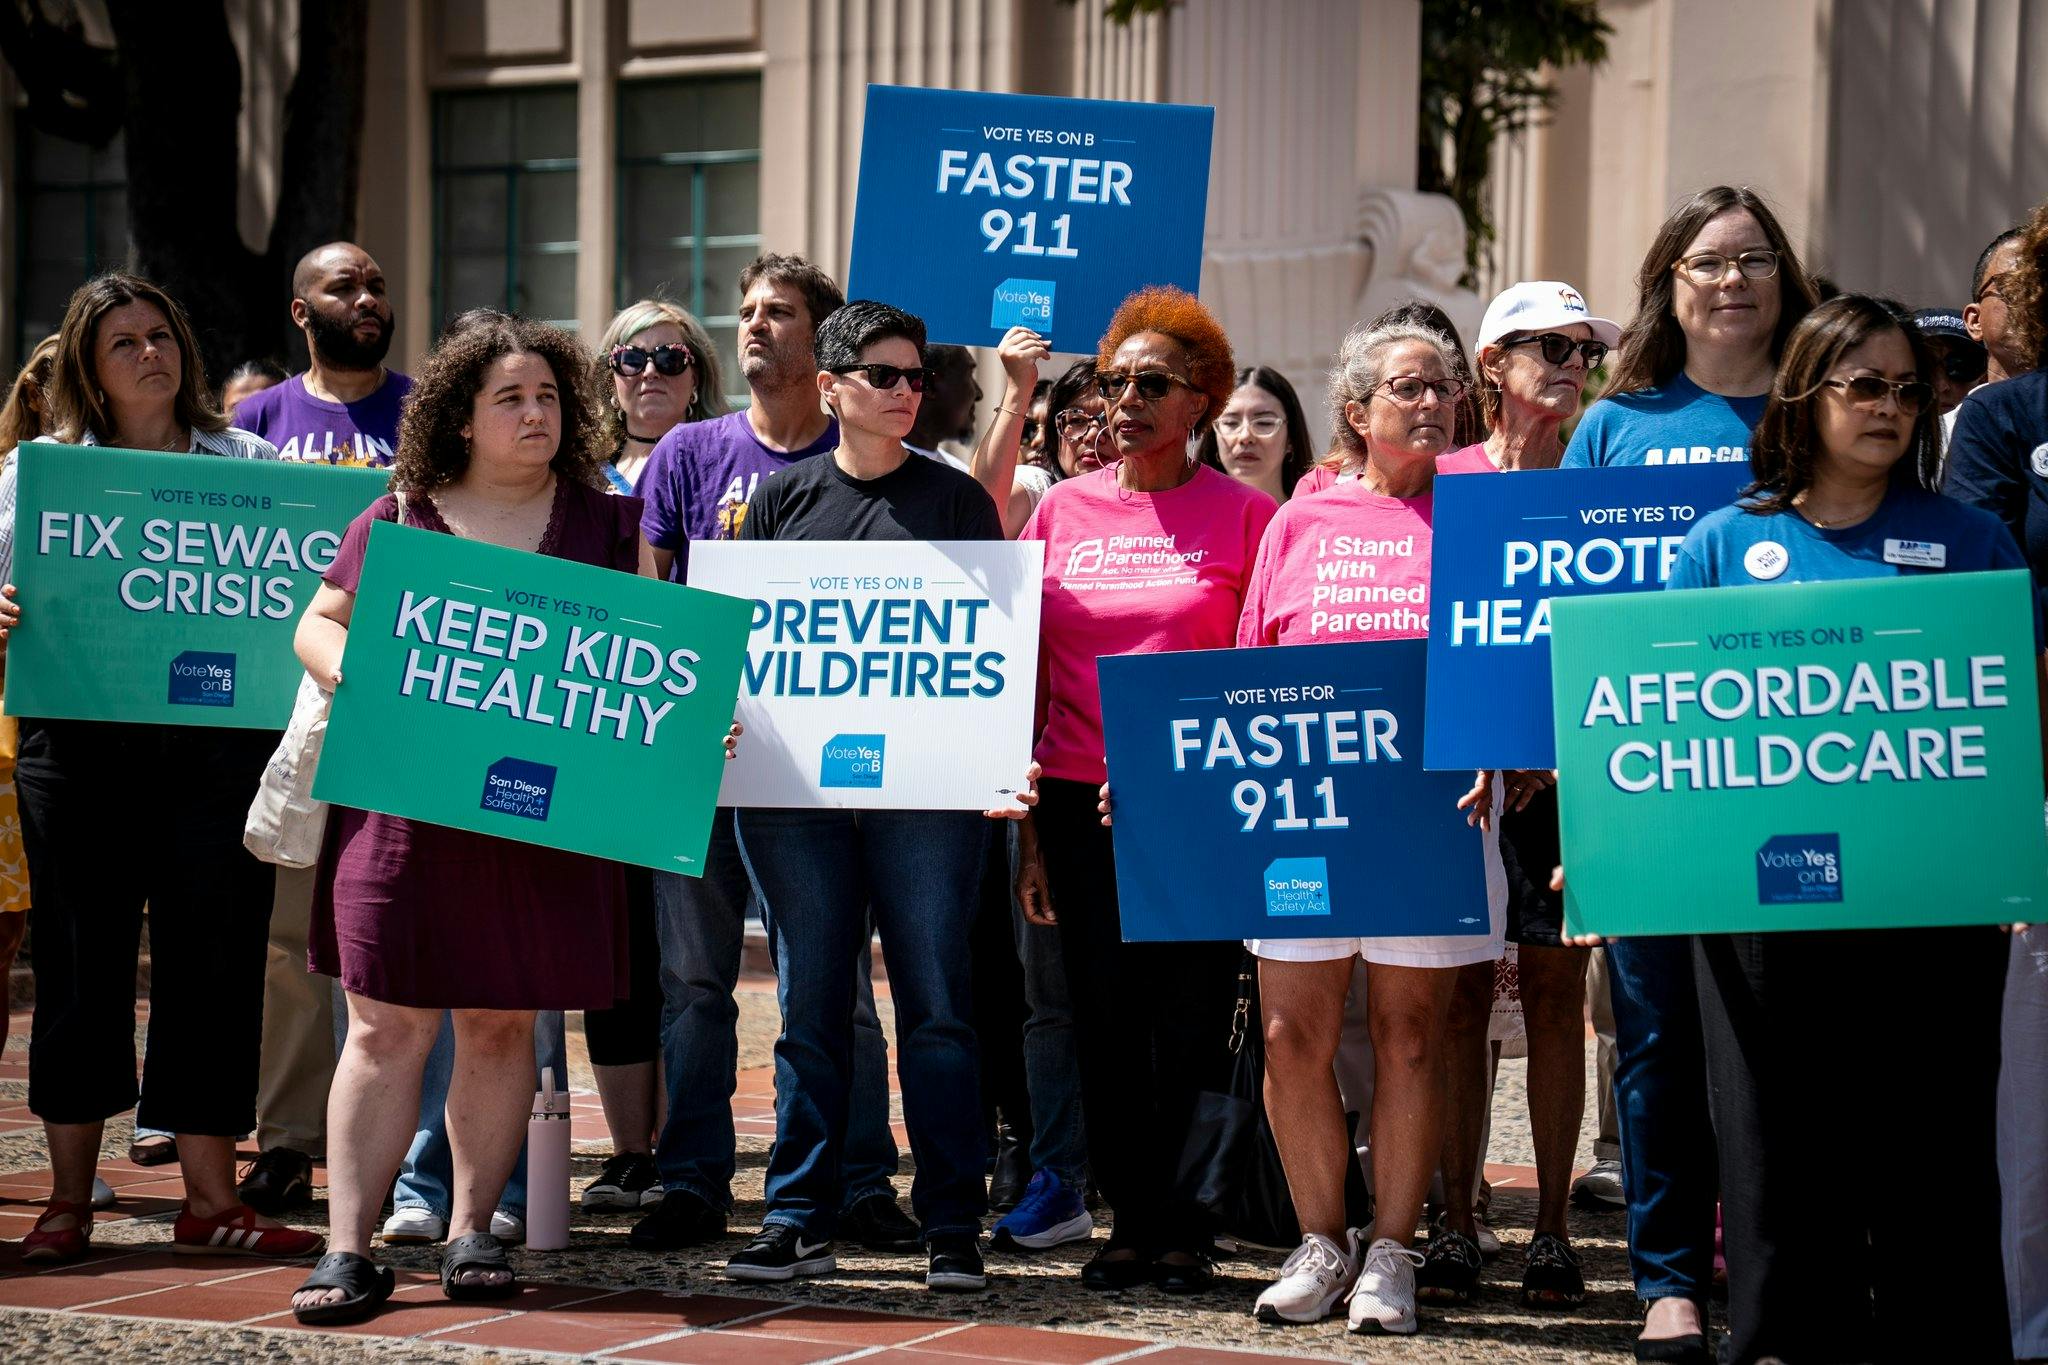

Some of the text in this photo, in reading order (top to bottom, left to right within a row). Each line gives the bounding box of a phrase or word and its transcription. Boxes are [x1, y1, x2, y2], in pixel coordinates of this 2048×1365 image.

[983, 126, 1095, 146] VOTE YES ON B
[936, 150, 1133, 206] FASTER
[979, 208, 1078, 259] 911
[278, 431, 395, 461] ALL IN
[150, 487, 272, 510] VOTE YES ON B
[1580, 505, 1695, 525] VOTE YES TO
[38, 511, 124, 560] FIX
[1108, 534, 1175, 550] Planned
[1318, 535, 1414, 559] I Stand
[1104, 549, 1203, 567] Parenthood
[1121, 566, 1133, 574] No
[1316, 559, 1376, 582] With
[118, 567, 294, 620] CRISIS
[809, 576, 923, 590] VOTE YES ON B
[1059, 575, 1197, 591] Planned Parenthood Action Fund
[504, 588, 609, 622] VOTE YES TO
[1312, 583, 1426, 609] Planned
[750, 598, 990, 645] PREVENT
[392, 590, 701, 696] KEEP KIDS
[1707, 626, 1864, 651] VOTE YES ON B
[400, 648, 676, 746] HEALTHY
[1224, 685, 1335, 705] VOTE YES FOR
[1579, 655, 2009, 729] AFFORDABLE
[1170, 709, 1403, 772] FASTER
[1607, 725, 1988, 794] CHILDCARE
[489, 774, 547, 796] San Diego
[495, 787, 535, 804] Health
[484, 795, 545, 817] Safety Act
[1230, 776, 1349, 832] 911
[1268, 879, 1323, 892] San Diego
[1277, 890, 1314, 901] Health
[1270, 900, 1326, 913] Safety Act
